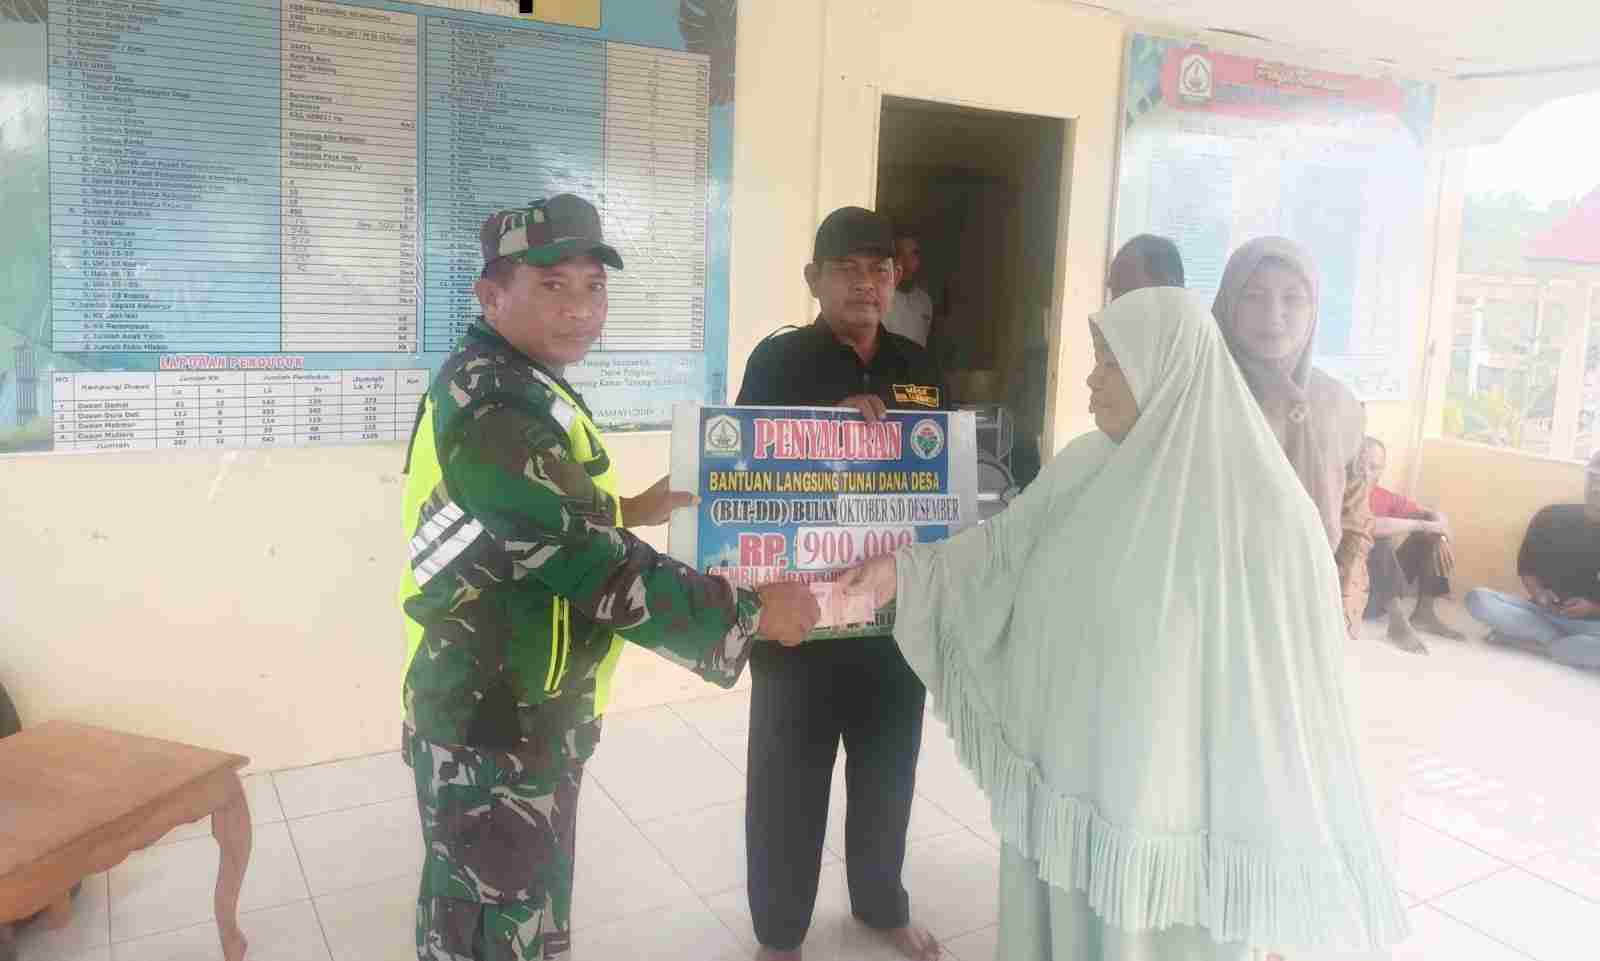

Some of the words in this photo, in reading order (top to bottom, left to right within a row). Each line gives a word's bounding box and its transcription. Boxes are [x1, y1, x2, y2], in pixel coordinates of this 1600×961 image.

[753, 419, 904, 461] PENYALURAN
[709, 471, 772, 492] BANTUAN
[776, 471, 839, 493] LANGSUNG
[842, 472, 876, 492] TUNAI
[879, 472, 908, 491] DANA
[911, 472, 940, 491] DESA
[711, 498, 789, 525] (BLT-DD)
[792, 499, 837, 524] BULAN
[838, 498, 888, 524] OKTOBER
[906, 498, 960, 522] DESEMBER
[739, 533, 787, 568] RP.
